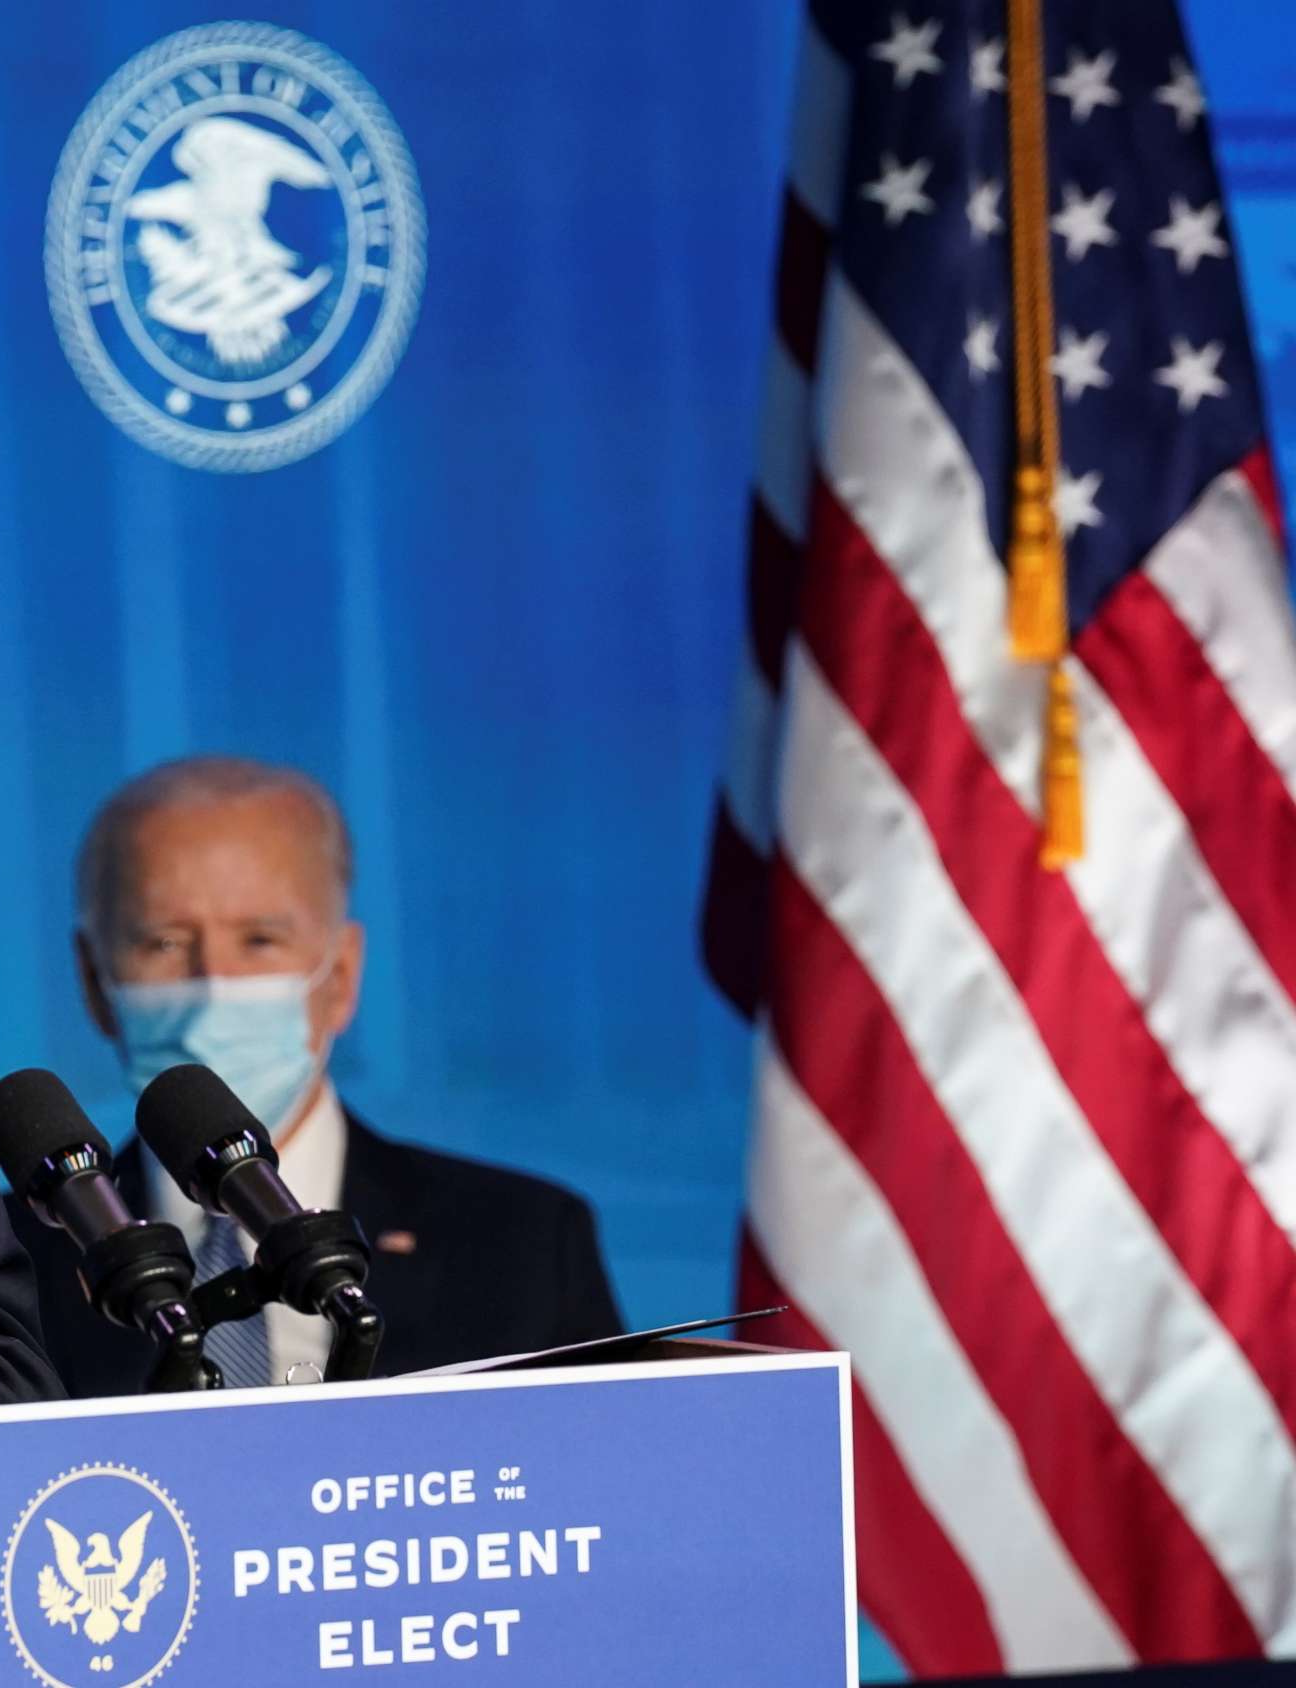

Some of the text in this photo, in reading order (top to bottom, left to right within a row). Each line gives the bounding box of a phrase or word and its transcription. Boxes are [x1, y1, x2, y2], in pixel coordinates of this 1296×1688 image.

[498, 1466, 521, 1482] OF
[311, 1469, 476, 1514] OFFICE
[494, 1485, 526, 1501] THE
[233, 1526, 602, 1598] PRESIDENT
[319, 1609, 521, 1669] ELECT
[89, 1655, 114, 1672] 46
